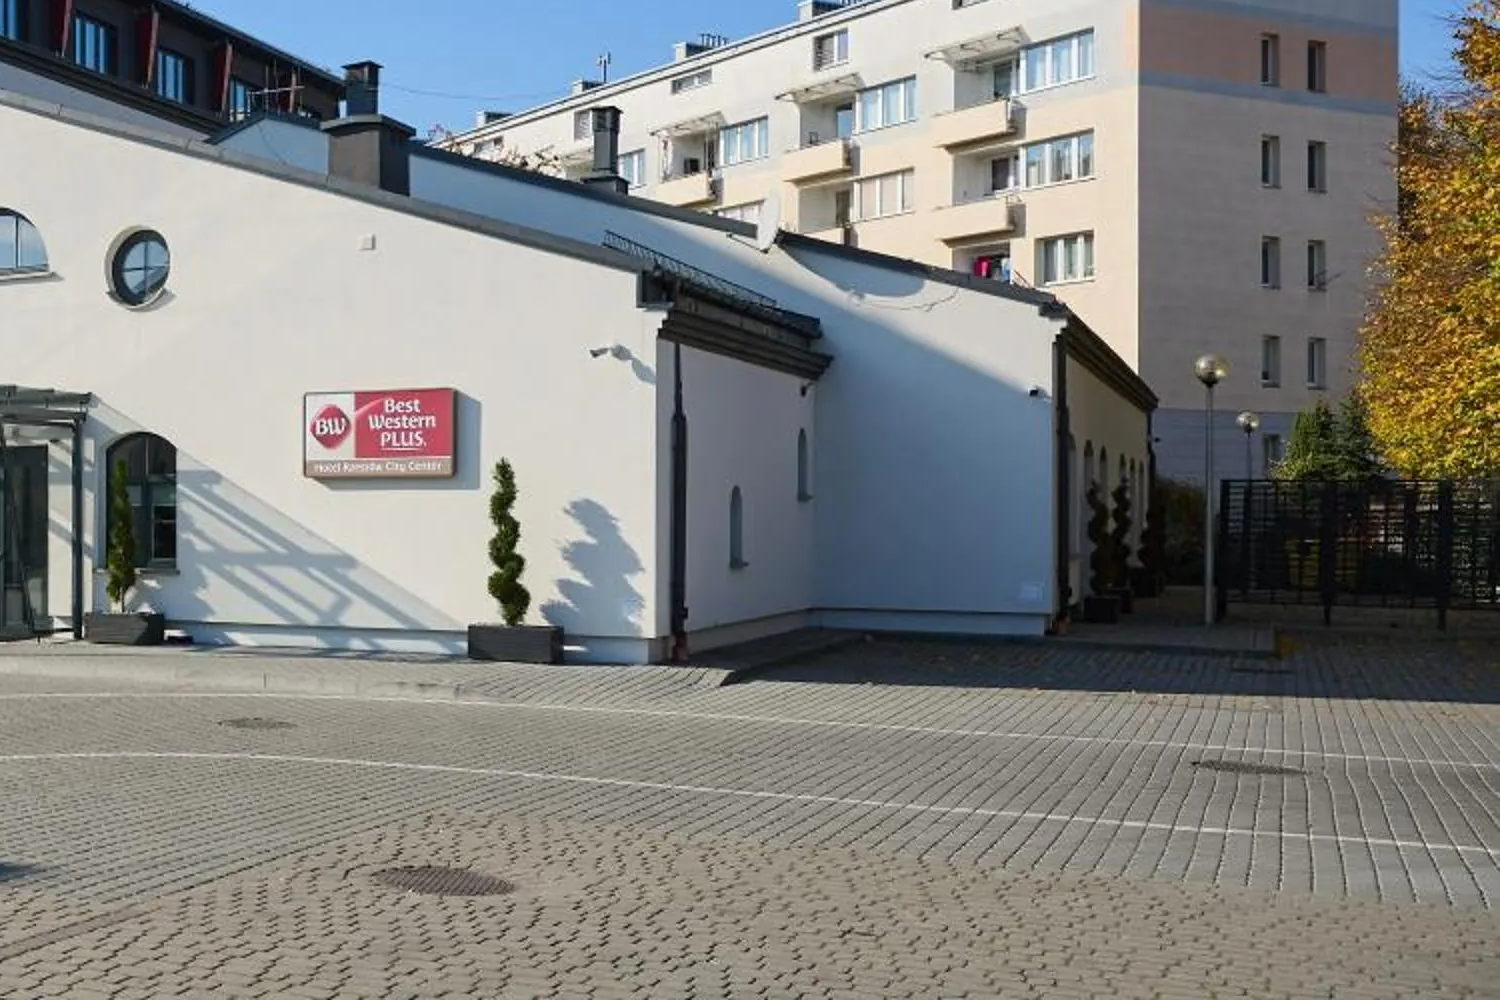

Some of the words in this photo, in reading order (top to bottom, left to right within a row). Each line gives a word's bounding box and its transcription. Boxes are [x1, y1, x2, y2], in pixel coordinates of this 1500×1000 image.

[384, 398, 421, 413] Best
[315, 417, 347, 436] BW
[368, 414, 437, 429] Western
